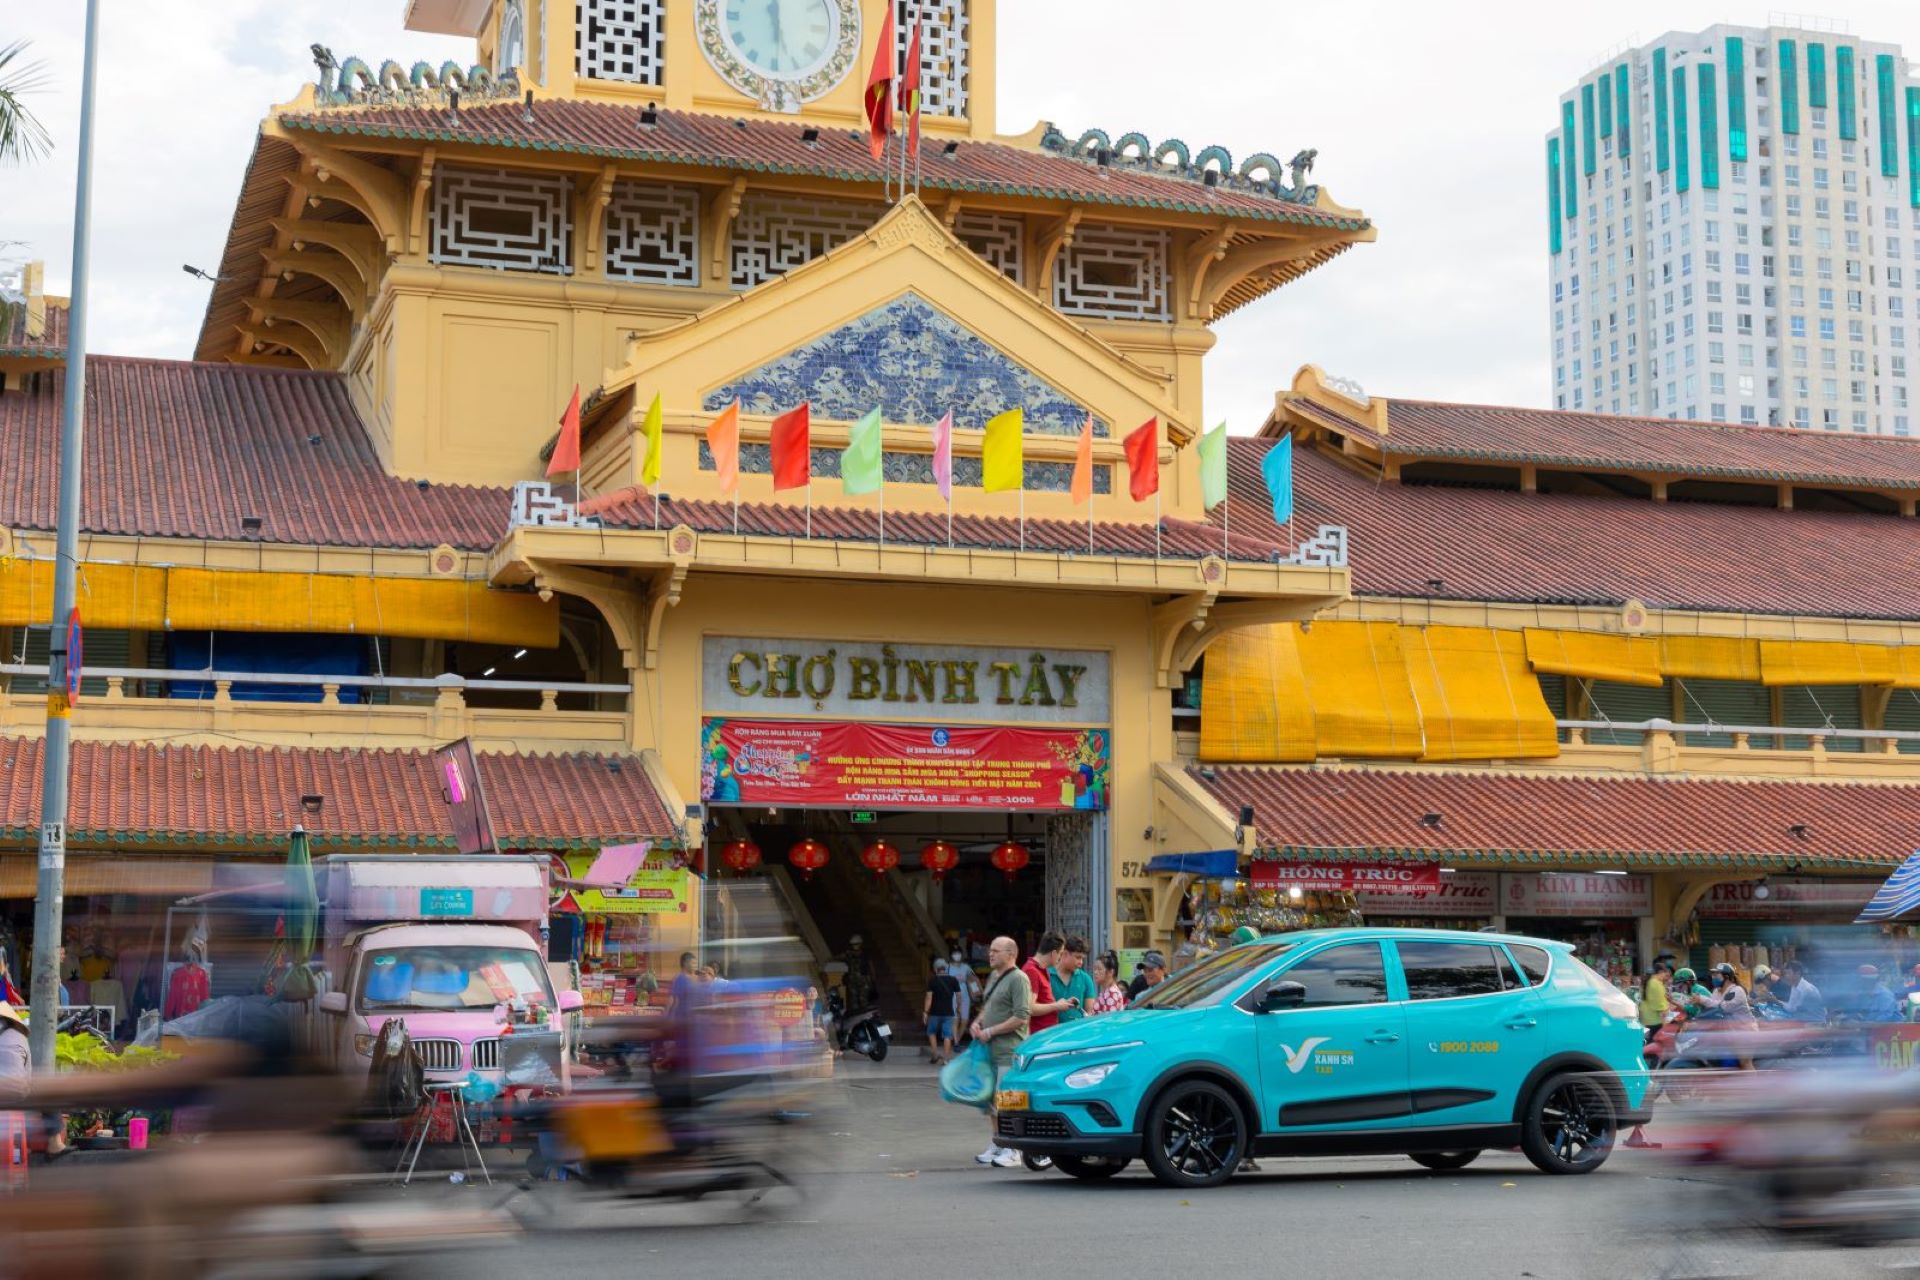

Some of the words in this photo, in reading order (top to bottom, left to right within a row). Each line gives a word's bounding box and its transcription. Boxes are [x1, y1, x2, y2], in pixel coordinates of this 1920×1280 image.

[727, 648, 837, 711] CHỢ
[847, 645, 980, 705] BÌNH
[989, 652, 1088, 707] TÂY
[1278, 864, 1345, 880] HỒNG
[1352, 866, 1413, 881] TRÚC
[1536, 877, 1577, 893] KIM
[1440, 1041, 1468, 1053] 1900
[1314, 1054, 1340, 1065] XANH
[1341, 1054, 1354, 1065] SM
